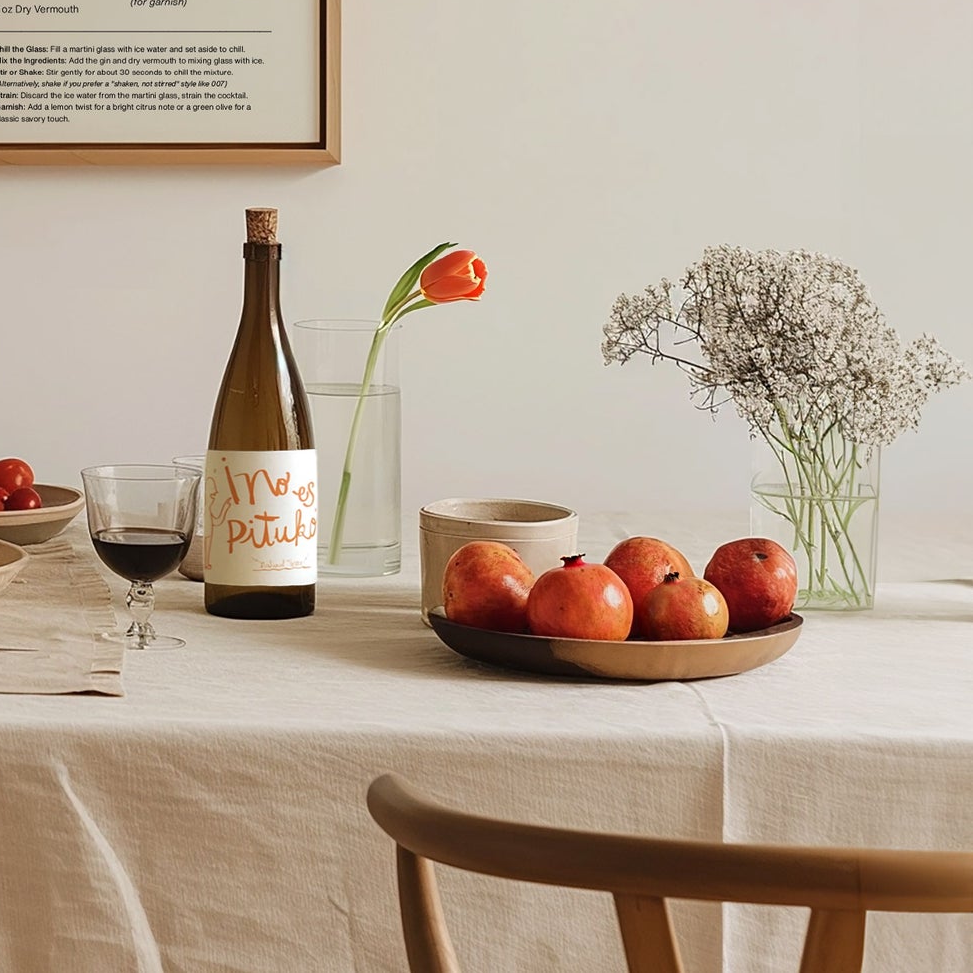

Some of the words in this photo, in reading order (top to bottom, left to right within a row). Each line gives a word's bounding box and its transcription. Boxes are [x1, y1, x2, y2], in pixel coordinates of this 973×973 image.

[15, 5, 31, 15] Dry
[34, 5, 79, 14] Vermouth
[96, 46, 115, 54] glass
[117, 46, 132, 54] with
[197, 46, 217, 54] aside
[23, 57, 67, 66] Ingredients:
[99, 57, 111, 66] gin
[112, 57, 127, 65] and
[128, 57, 140, 66] dry
[142, 57, 177, 65] vermouth
[187, 57, 212, 66] mixing
[213, 57, 233, 66] glass
[60, 69, 83, 77] gently
[82, 80, 103, 88] prefer
[211, 80, 228, 88] 007)
[158, 92, 180, 101] glass,
[50, 103, 73, 112] lemon
[112, 104, 134, 112] bright
